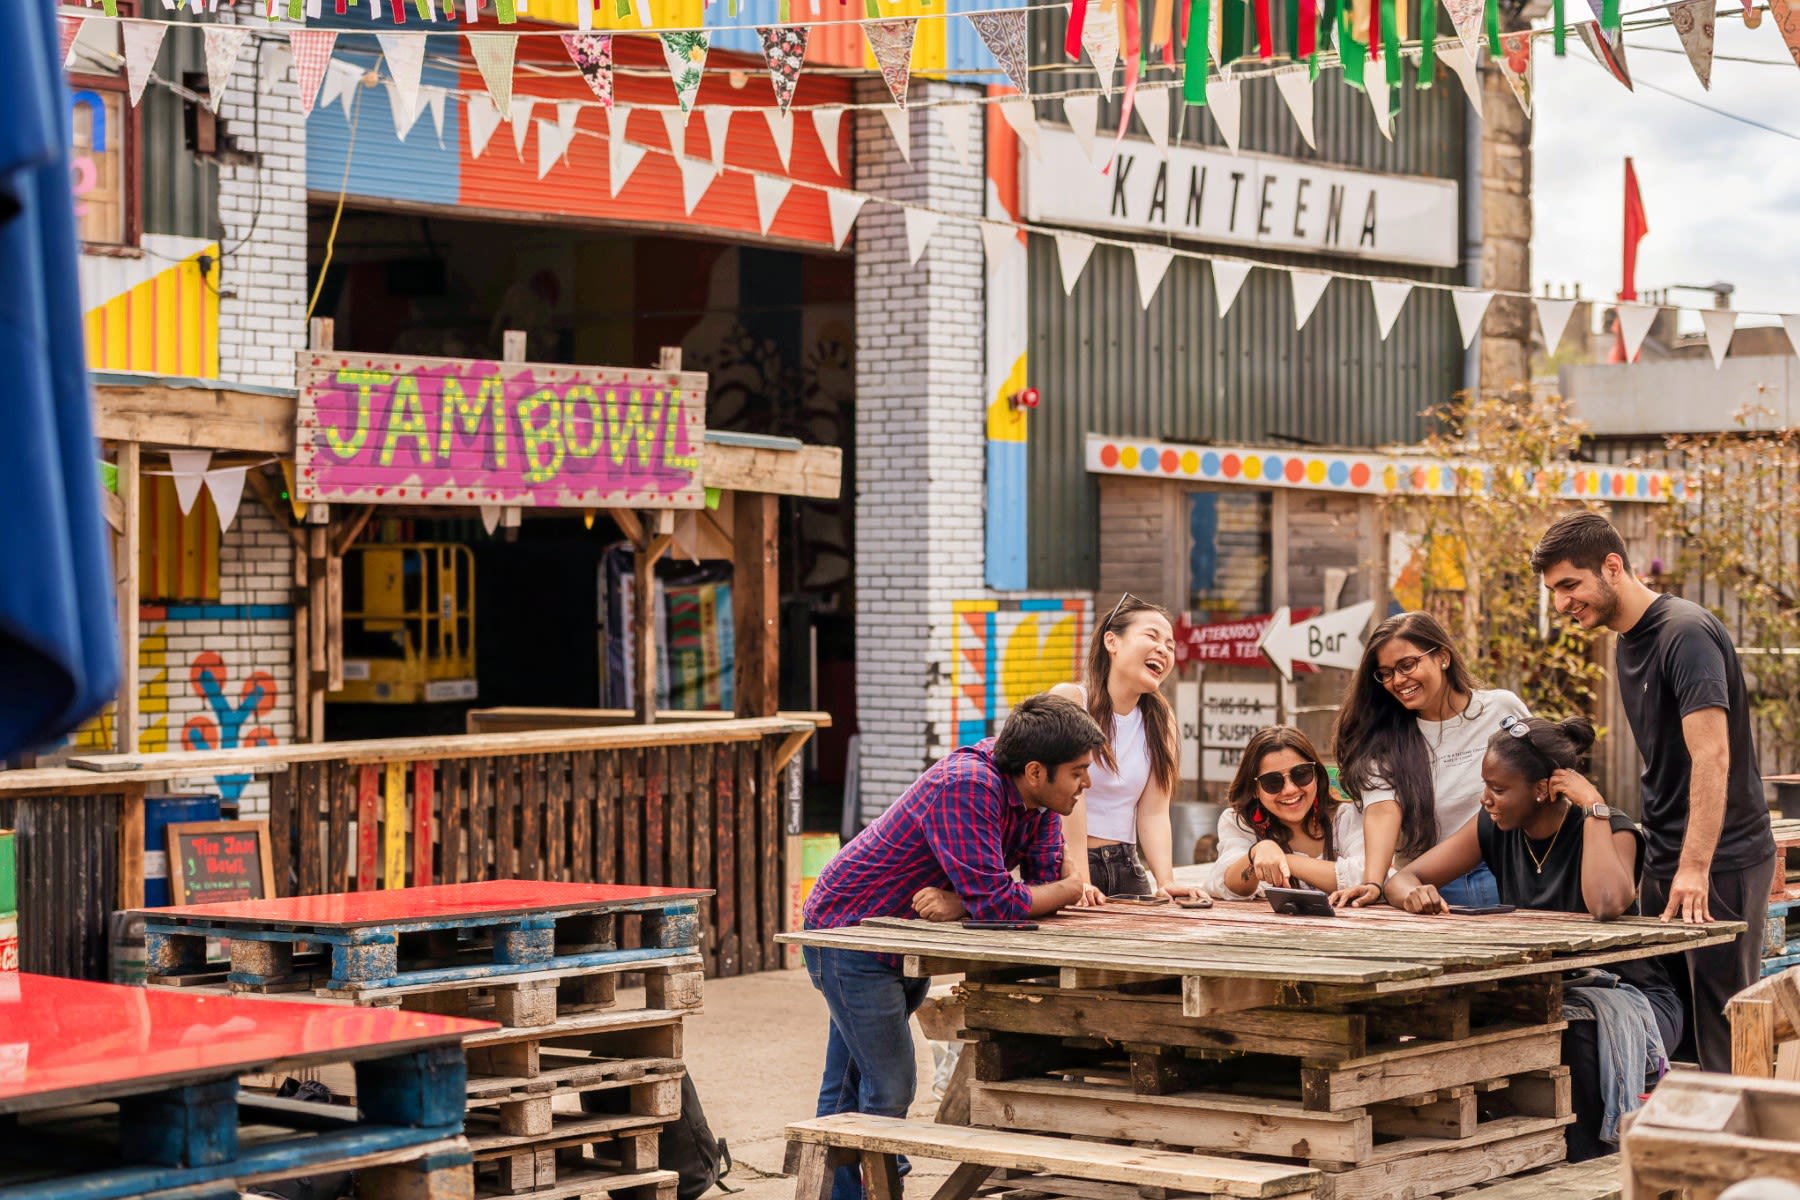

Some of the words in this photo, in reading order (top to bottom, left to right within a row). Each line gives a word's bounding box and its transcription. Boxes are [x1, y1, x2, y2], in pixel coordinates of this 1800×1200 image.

[1111, 154, 1377, 248] KANTEENA
[1198, 643, 1230, 659] TEA
[1308, 625, 1347, 657] Bar
